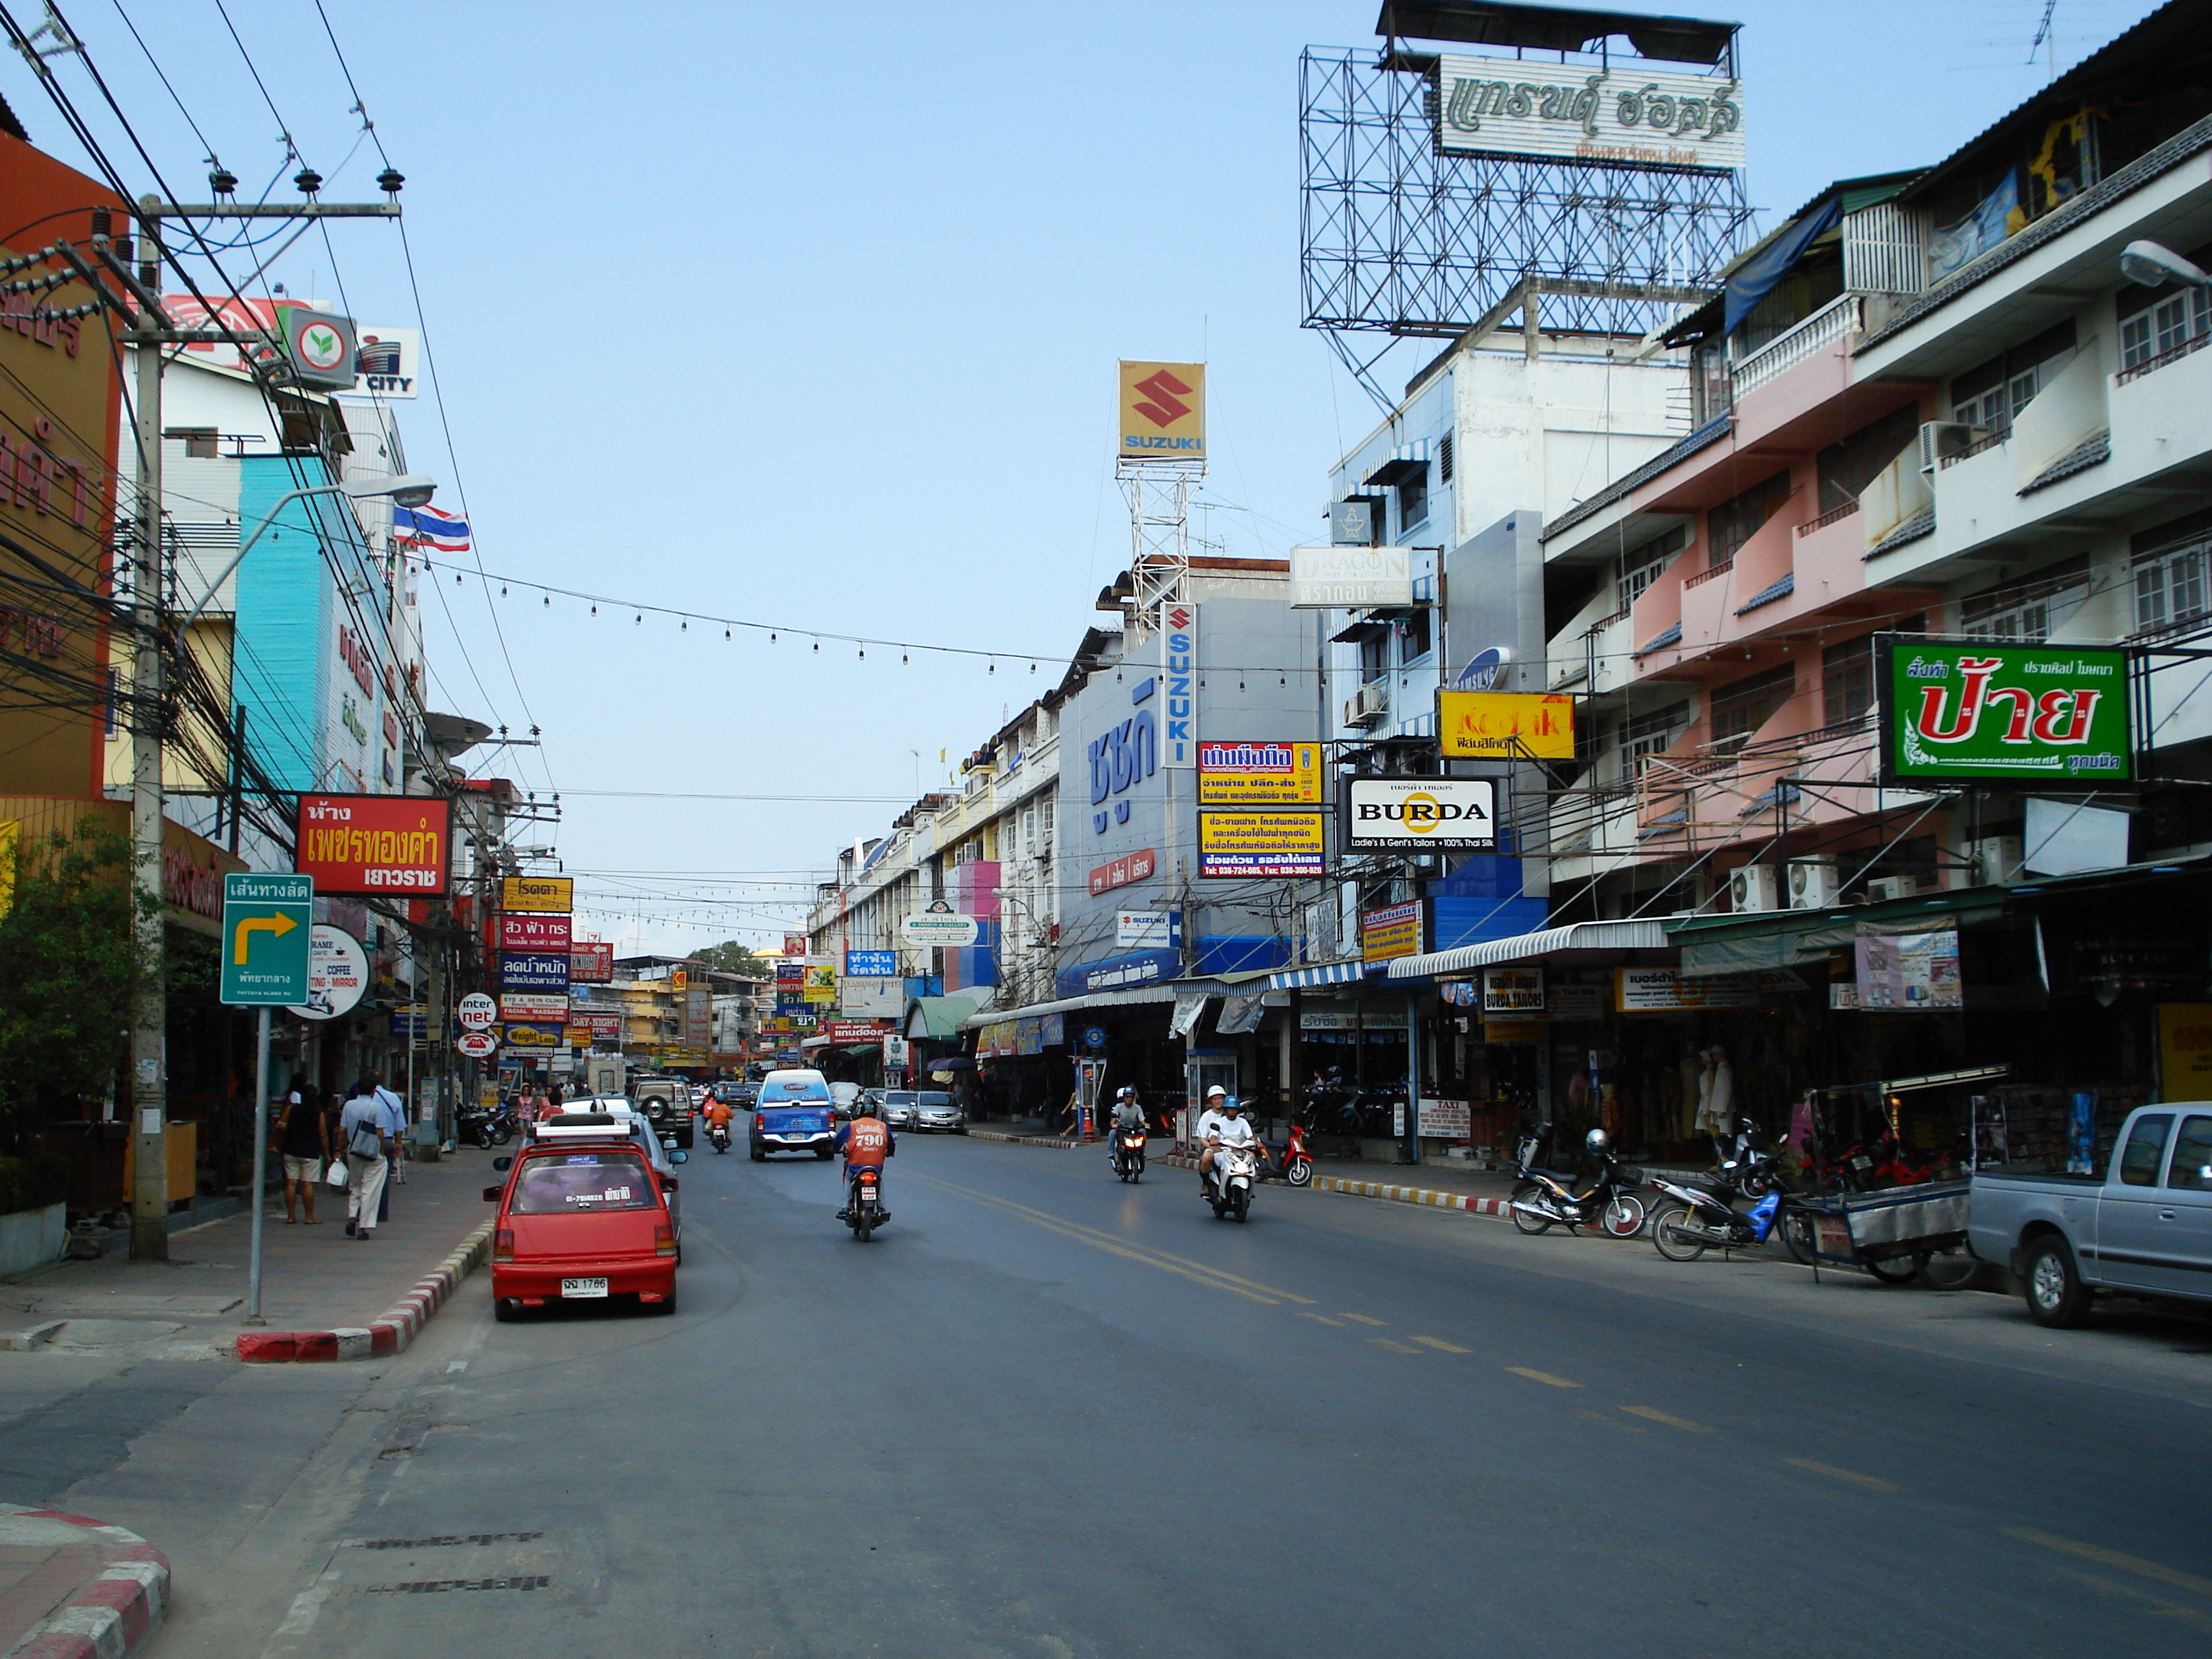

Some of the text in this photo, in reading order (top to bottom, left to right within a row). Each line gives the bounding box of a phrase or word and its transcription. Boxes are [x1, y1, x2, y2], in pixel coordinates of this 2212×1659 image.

[1617, 78, 1740, 139] ฮอลล์
[367, 375, 413, 392] CITY
[1125, 436, 1201, 450] SUZUKI
[1301, 552, 1406, 577] DRAGON
[1300, 585, 1367, 602] ดรากอน
[1169, 634, 1190, 761] SUZUKI
[1918, 657, 2103, 745] ป้าย
[2067, 752, 2121, 774] ทุกชนิด
[1203, 778, 1245, 788] จำหน่าย
[307, 801, 351, 821] ห้าง
[1357, 804, 1488, 821] BURDA
[307, 817, 439, 865] เพชรทองคำ
[1352, 839, 1377, 848] Ladie's
[1387, 839, 1411, 848] Gent's
[1413, 838, 1436, 848] Tailors
[1444, 838, 1463, 848] 100%
[1465, 839, 1480, 848] Thai
[1482, 839, 1495, 848] Silk
[364, 869, 436, 887] เยาวราช
[230, 878, 308, 897] เส้นทางลัด
[505, 920, 521, 934] สิว
[549, 924, 567, 935] กระ
[503, 956, 566, 974] ลดน้ำหนัก
[601, 953, 610, 971] 2
[850, 952, 892, 963] ทำฟัน
[327, 965, 351, 976] COFFEE
[850, 963, 893, 975] จัดฟัน
[239, 971, 291, 984] พัทยากลาง
[331, 977, 358, 987] MIRROR
[463, 999, 492, 1008] inter
[1486, 993, 1542, 1008] BURDA TAILORS
[463, 1011, 492, 1022] net
[797, 1016, 817, 1026] ยา
[511, 1031, 537, 1042] Weight
[855, 1134, 884, 1146] 790
